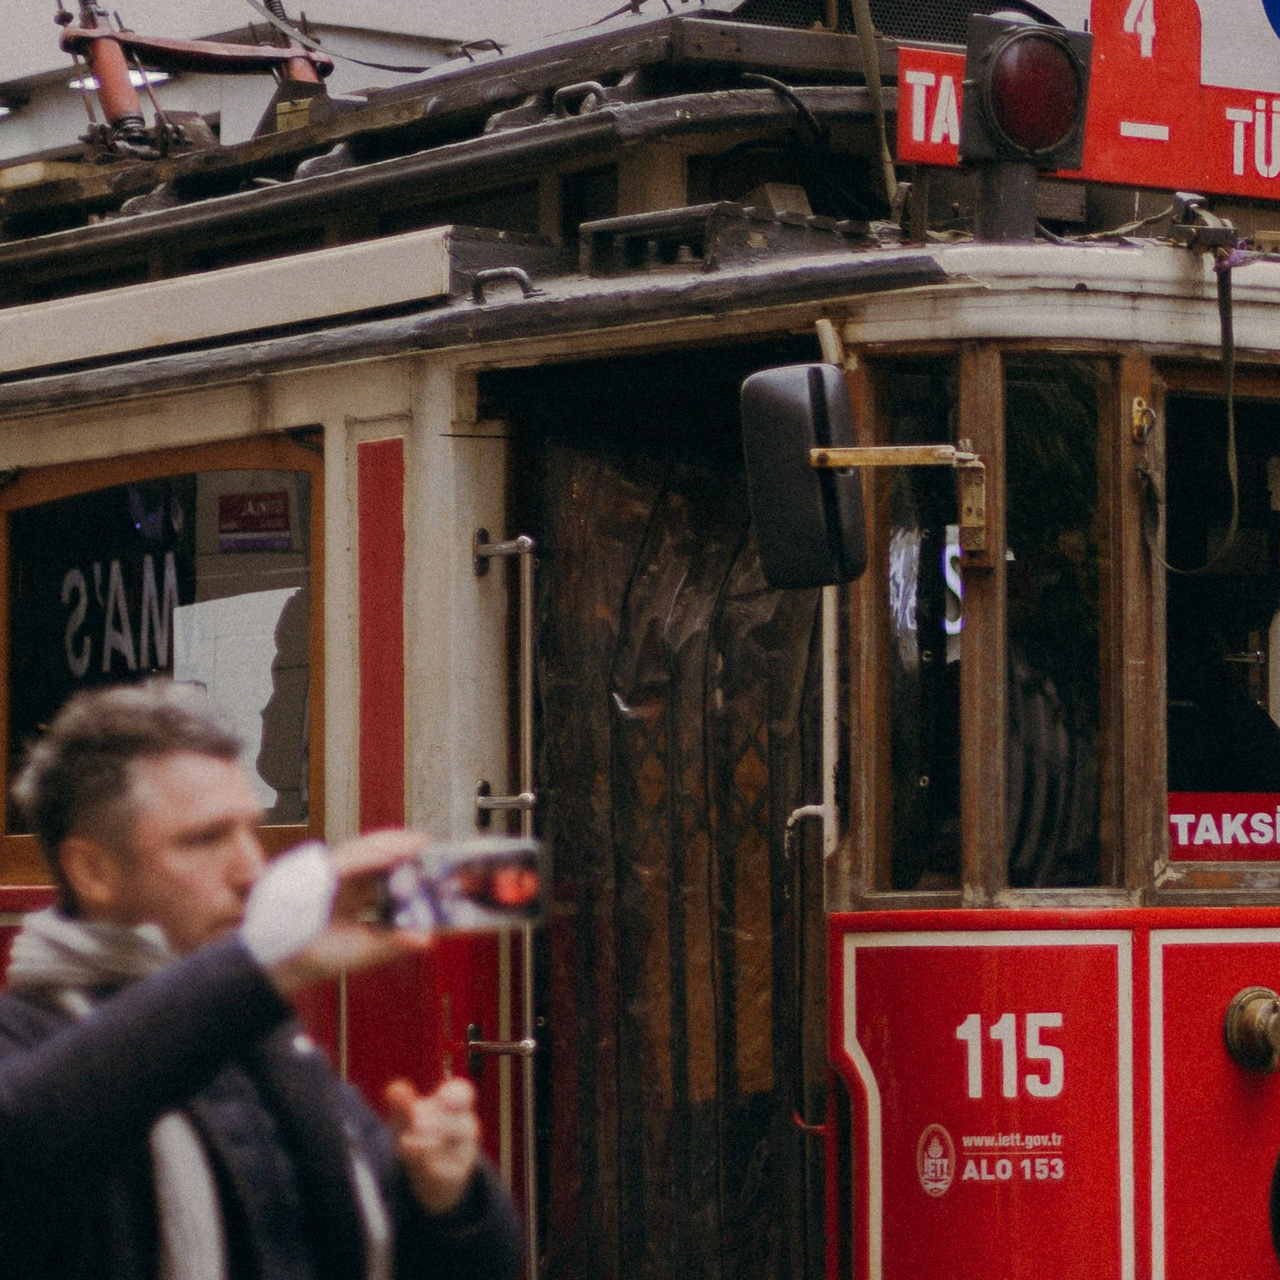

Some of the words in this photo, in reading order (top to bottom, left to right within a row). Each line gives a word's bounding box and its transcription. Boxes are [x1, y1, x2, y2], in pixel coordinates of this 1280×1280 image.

[956, 1013, 1064, 1099] 115
[961, 1133, 1063, 1149] www.iett.gov.tr
[961, 1159, 1013, 1180] ALO
[1020, 1158, 1064, 1180] 153
